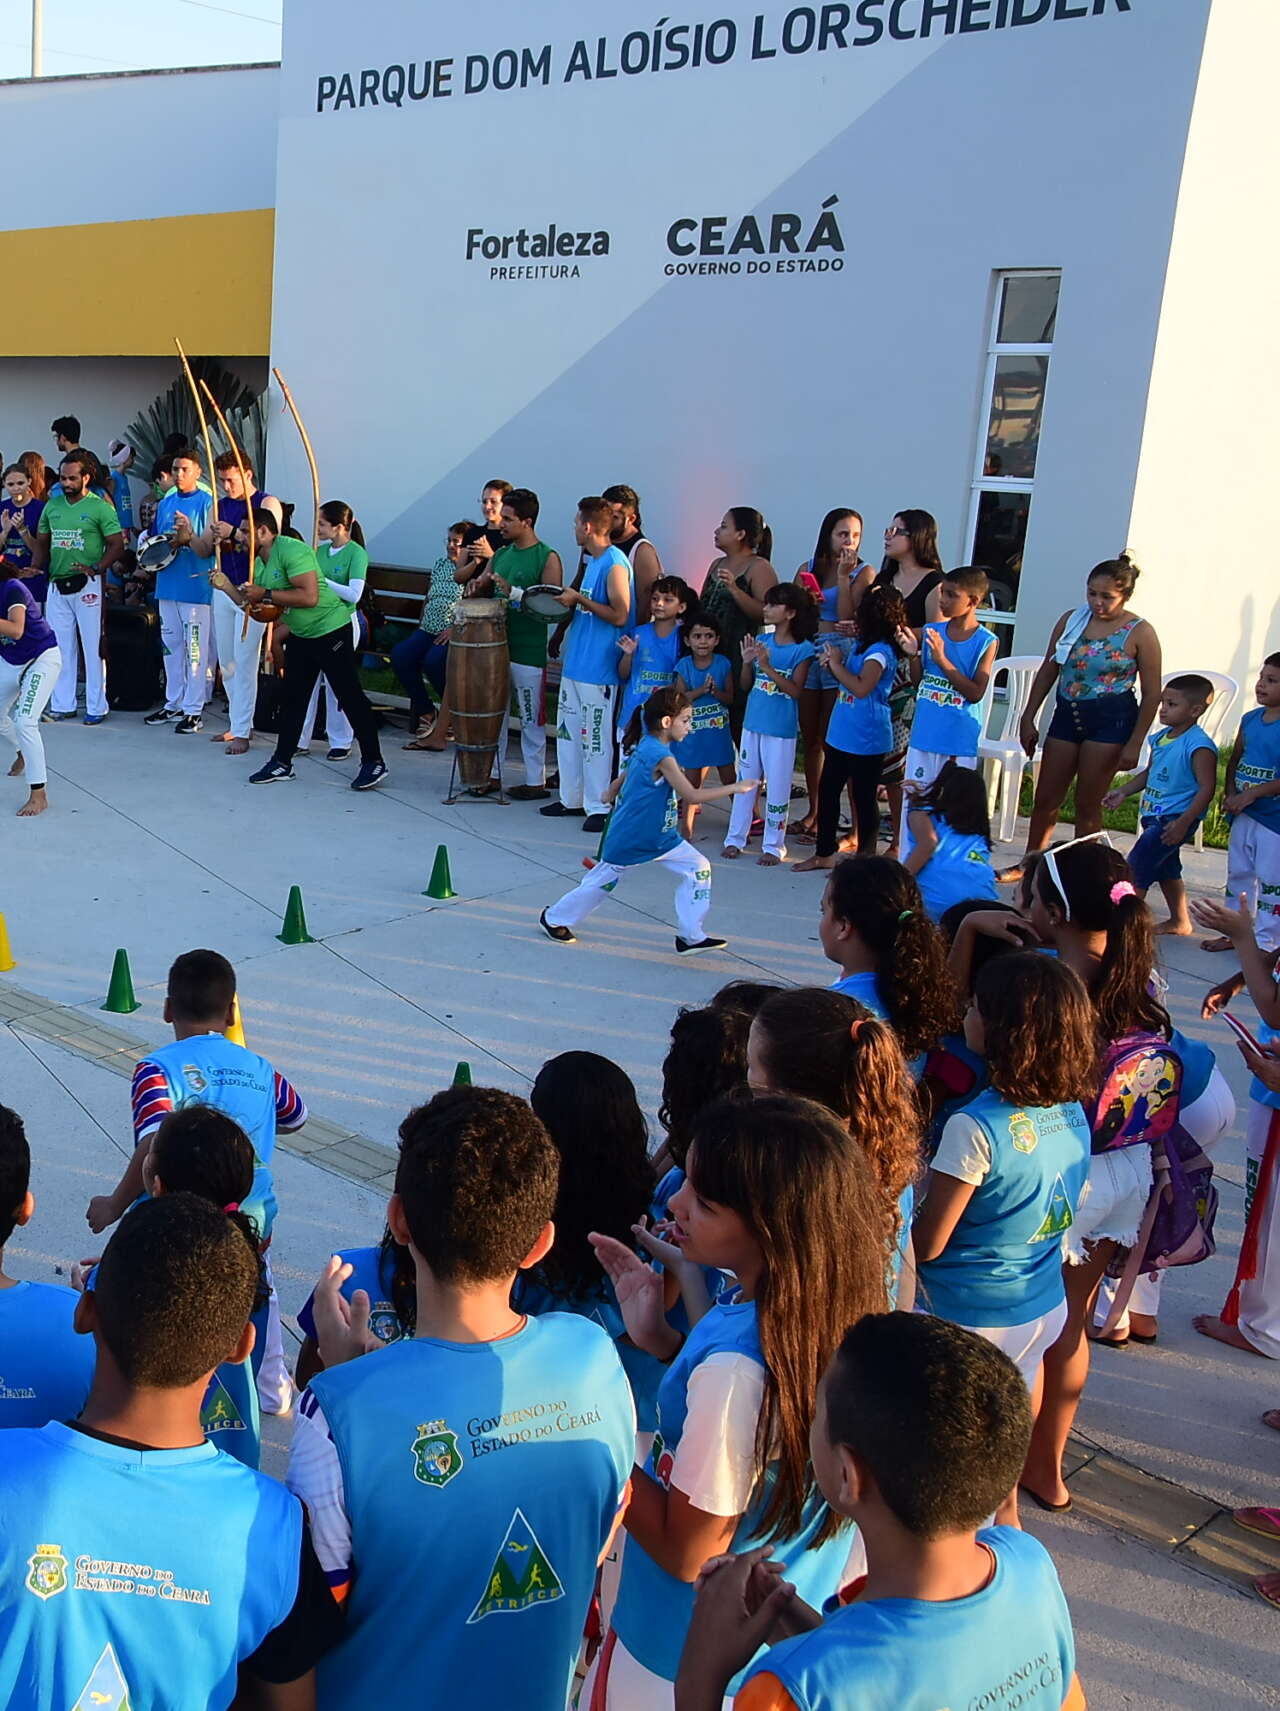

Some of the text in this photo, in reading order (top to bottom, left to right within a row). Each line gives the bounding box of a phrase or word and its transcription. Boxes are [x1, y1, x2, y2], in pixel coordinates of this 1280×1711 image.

[317, 58, 454, 112] PARQUE
[464, 45, 551, 95] DOM
[563, 17, 738, 83] ALOÍSIO
[466, 223, 610, 260] Fortaleza
[666, 194, 845, 256] CEARÁ
[490, 264, 581, 280] PREFEITURA
[664, 258, 844, 276] GOVERNO DO ESTADO
[21, 674, 42, 715] ESPORTE
[592, 707, 603, 753] ESPORTE
[466, 1400, 567, 1437] GOVERNO DO
[470, 1404, 602, 1458] ESTADO DO CEARÁ
[75, 1555, 173, 1580] GOVERNO DO
[75, 1572, 210, 1605] ESTADO DO CEARÁ
